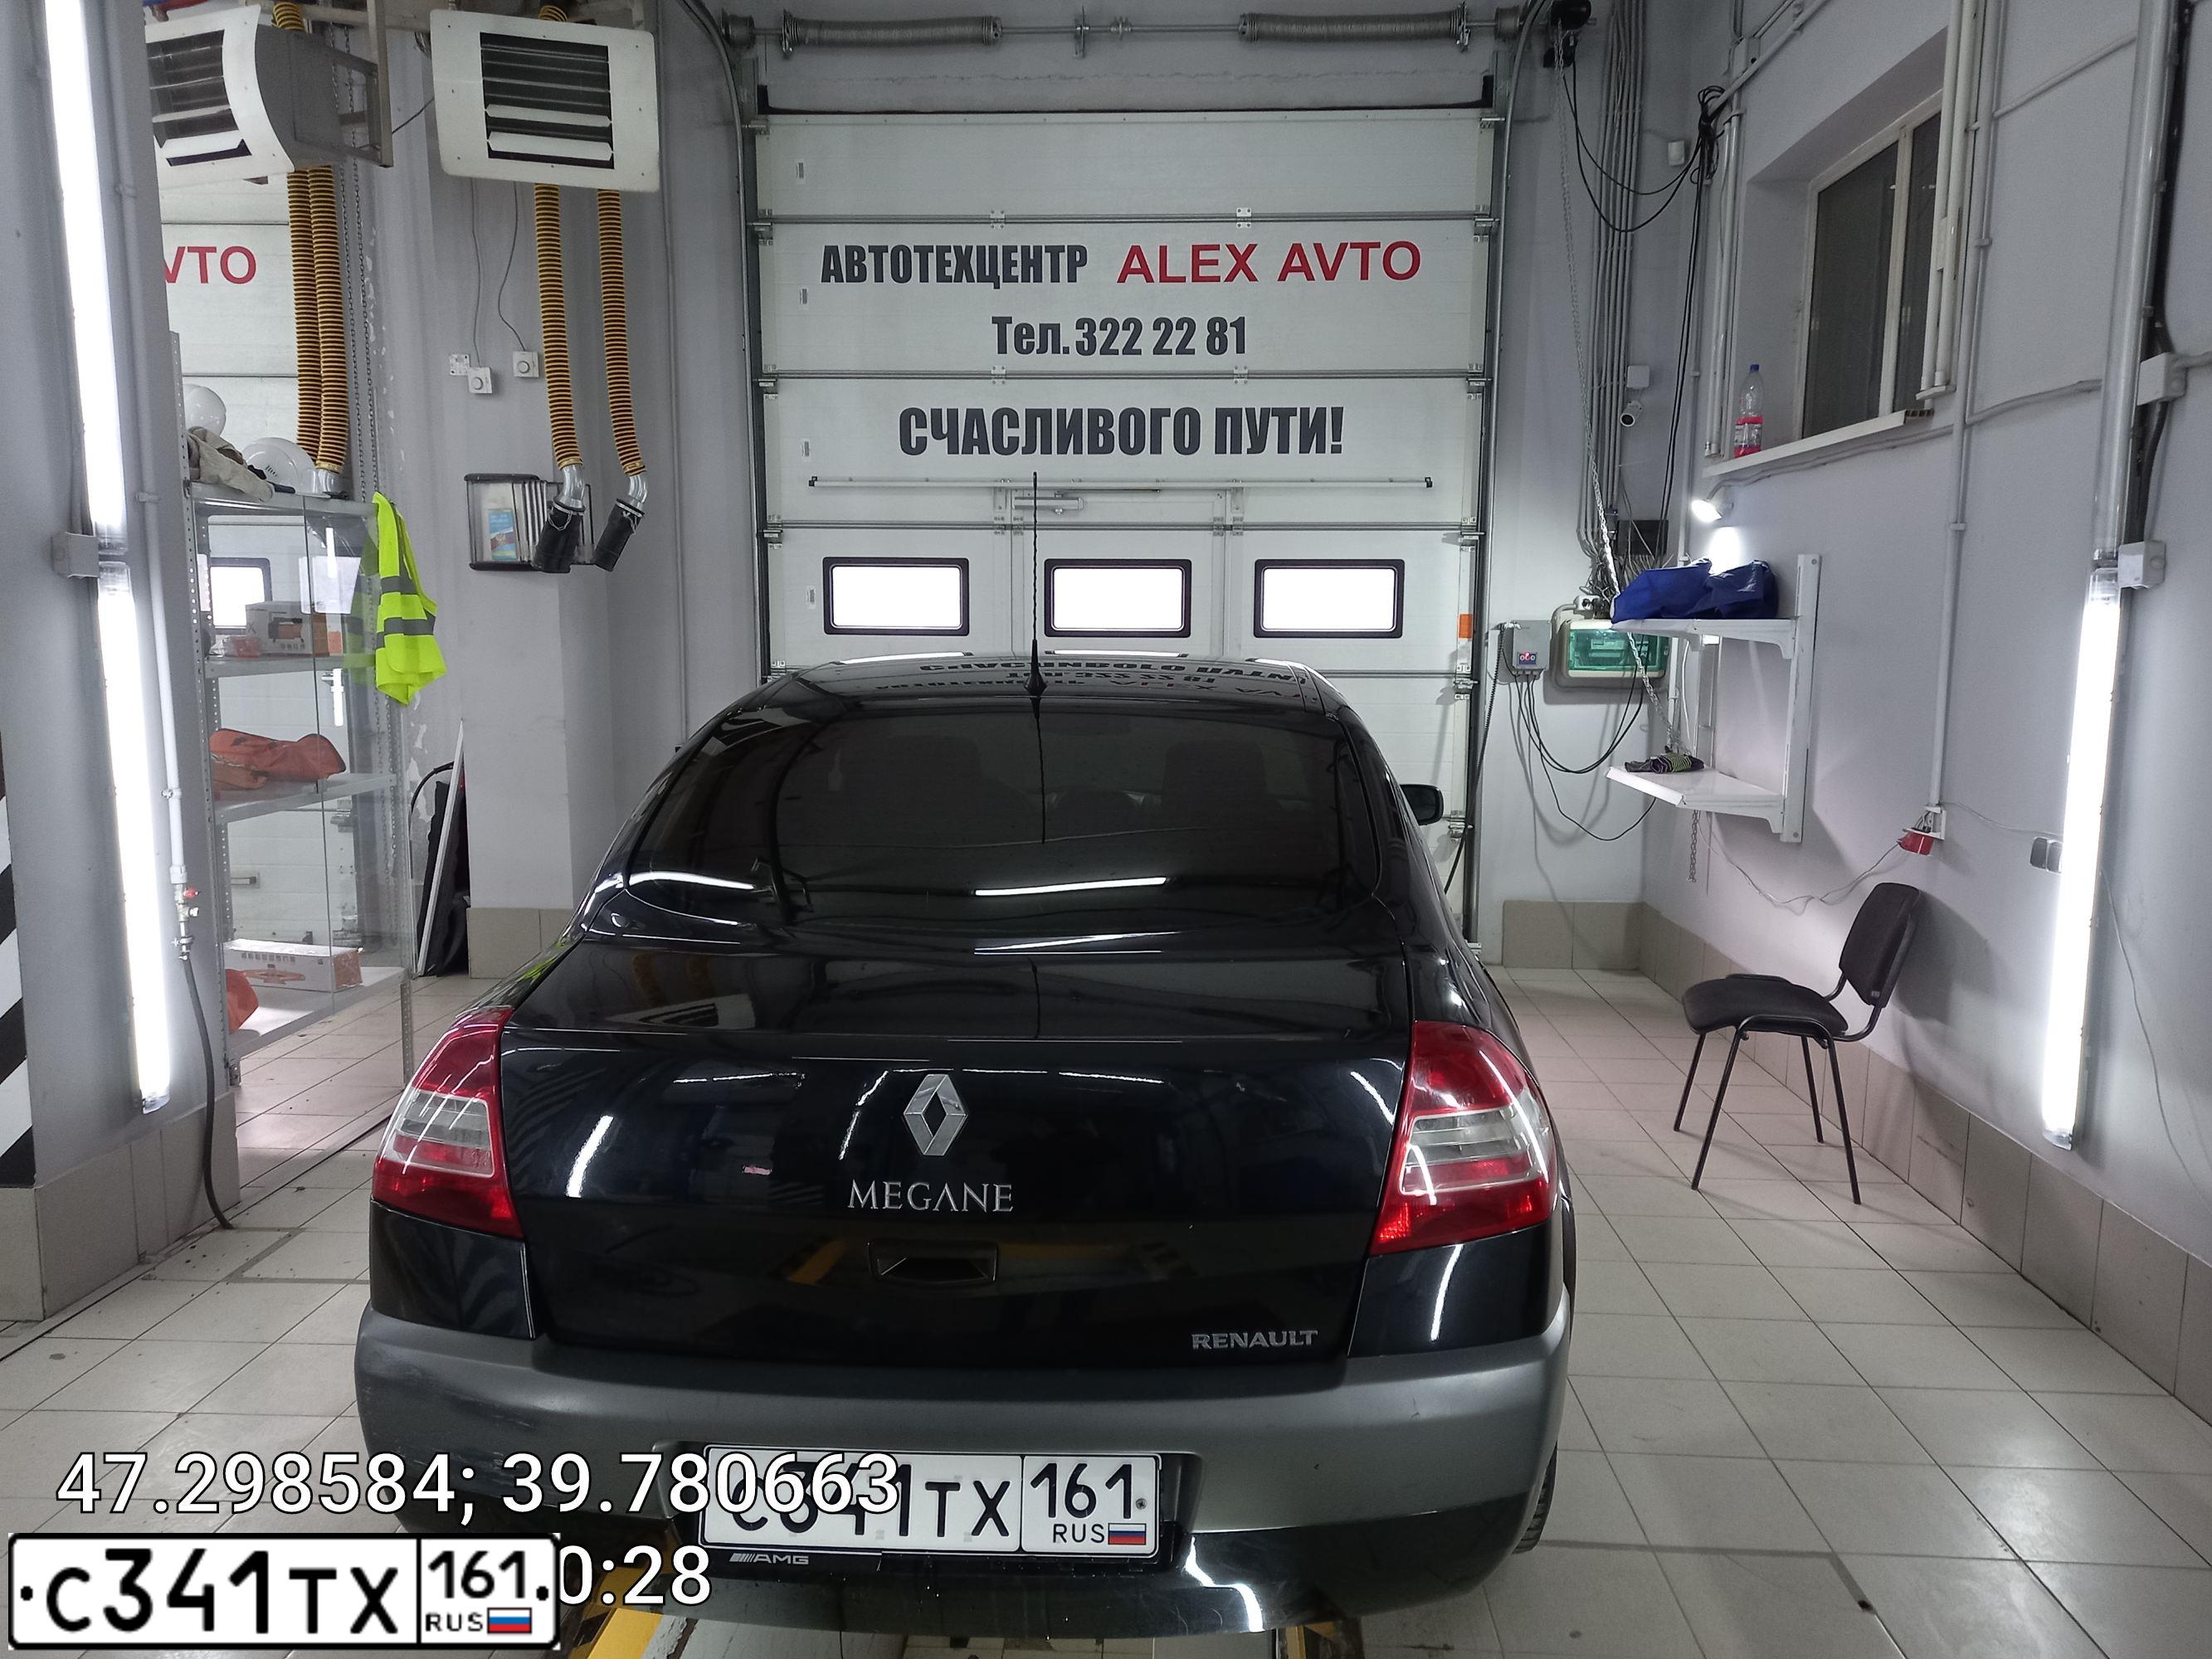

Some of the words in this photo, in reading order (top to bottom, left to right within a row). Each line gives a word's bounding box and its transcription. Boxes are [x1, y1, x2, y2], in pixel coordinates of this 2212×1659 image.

[821, 244, 1087, 289] АВТОТЕХЦЕНТР
[1117, 244, 1259, 284] ALEX
[1277, 241, 1420, 282] AVTO
[992, 316, 1070, 355] Тел.
[1075, 317, 1143, 356] 322
[1152, 317, 1196, 355] 22
[1206, 316, 1245, 355] 81
[899, 406, 1201, 455] СЧАСЛИВОГО
[1215, 406, 1344, 455] ПУТИ!
[846, 1180, 1014, 1213] MEGANE
[1192, 1330, 1318, 1350] RENAULT
[1030, 1462, 1133, 1520] 161
[1053, 1523, 1105, 1544] RUS
[753, 1554, 810, 1565] AMG
